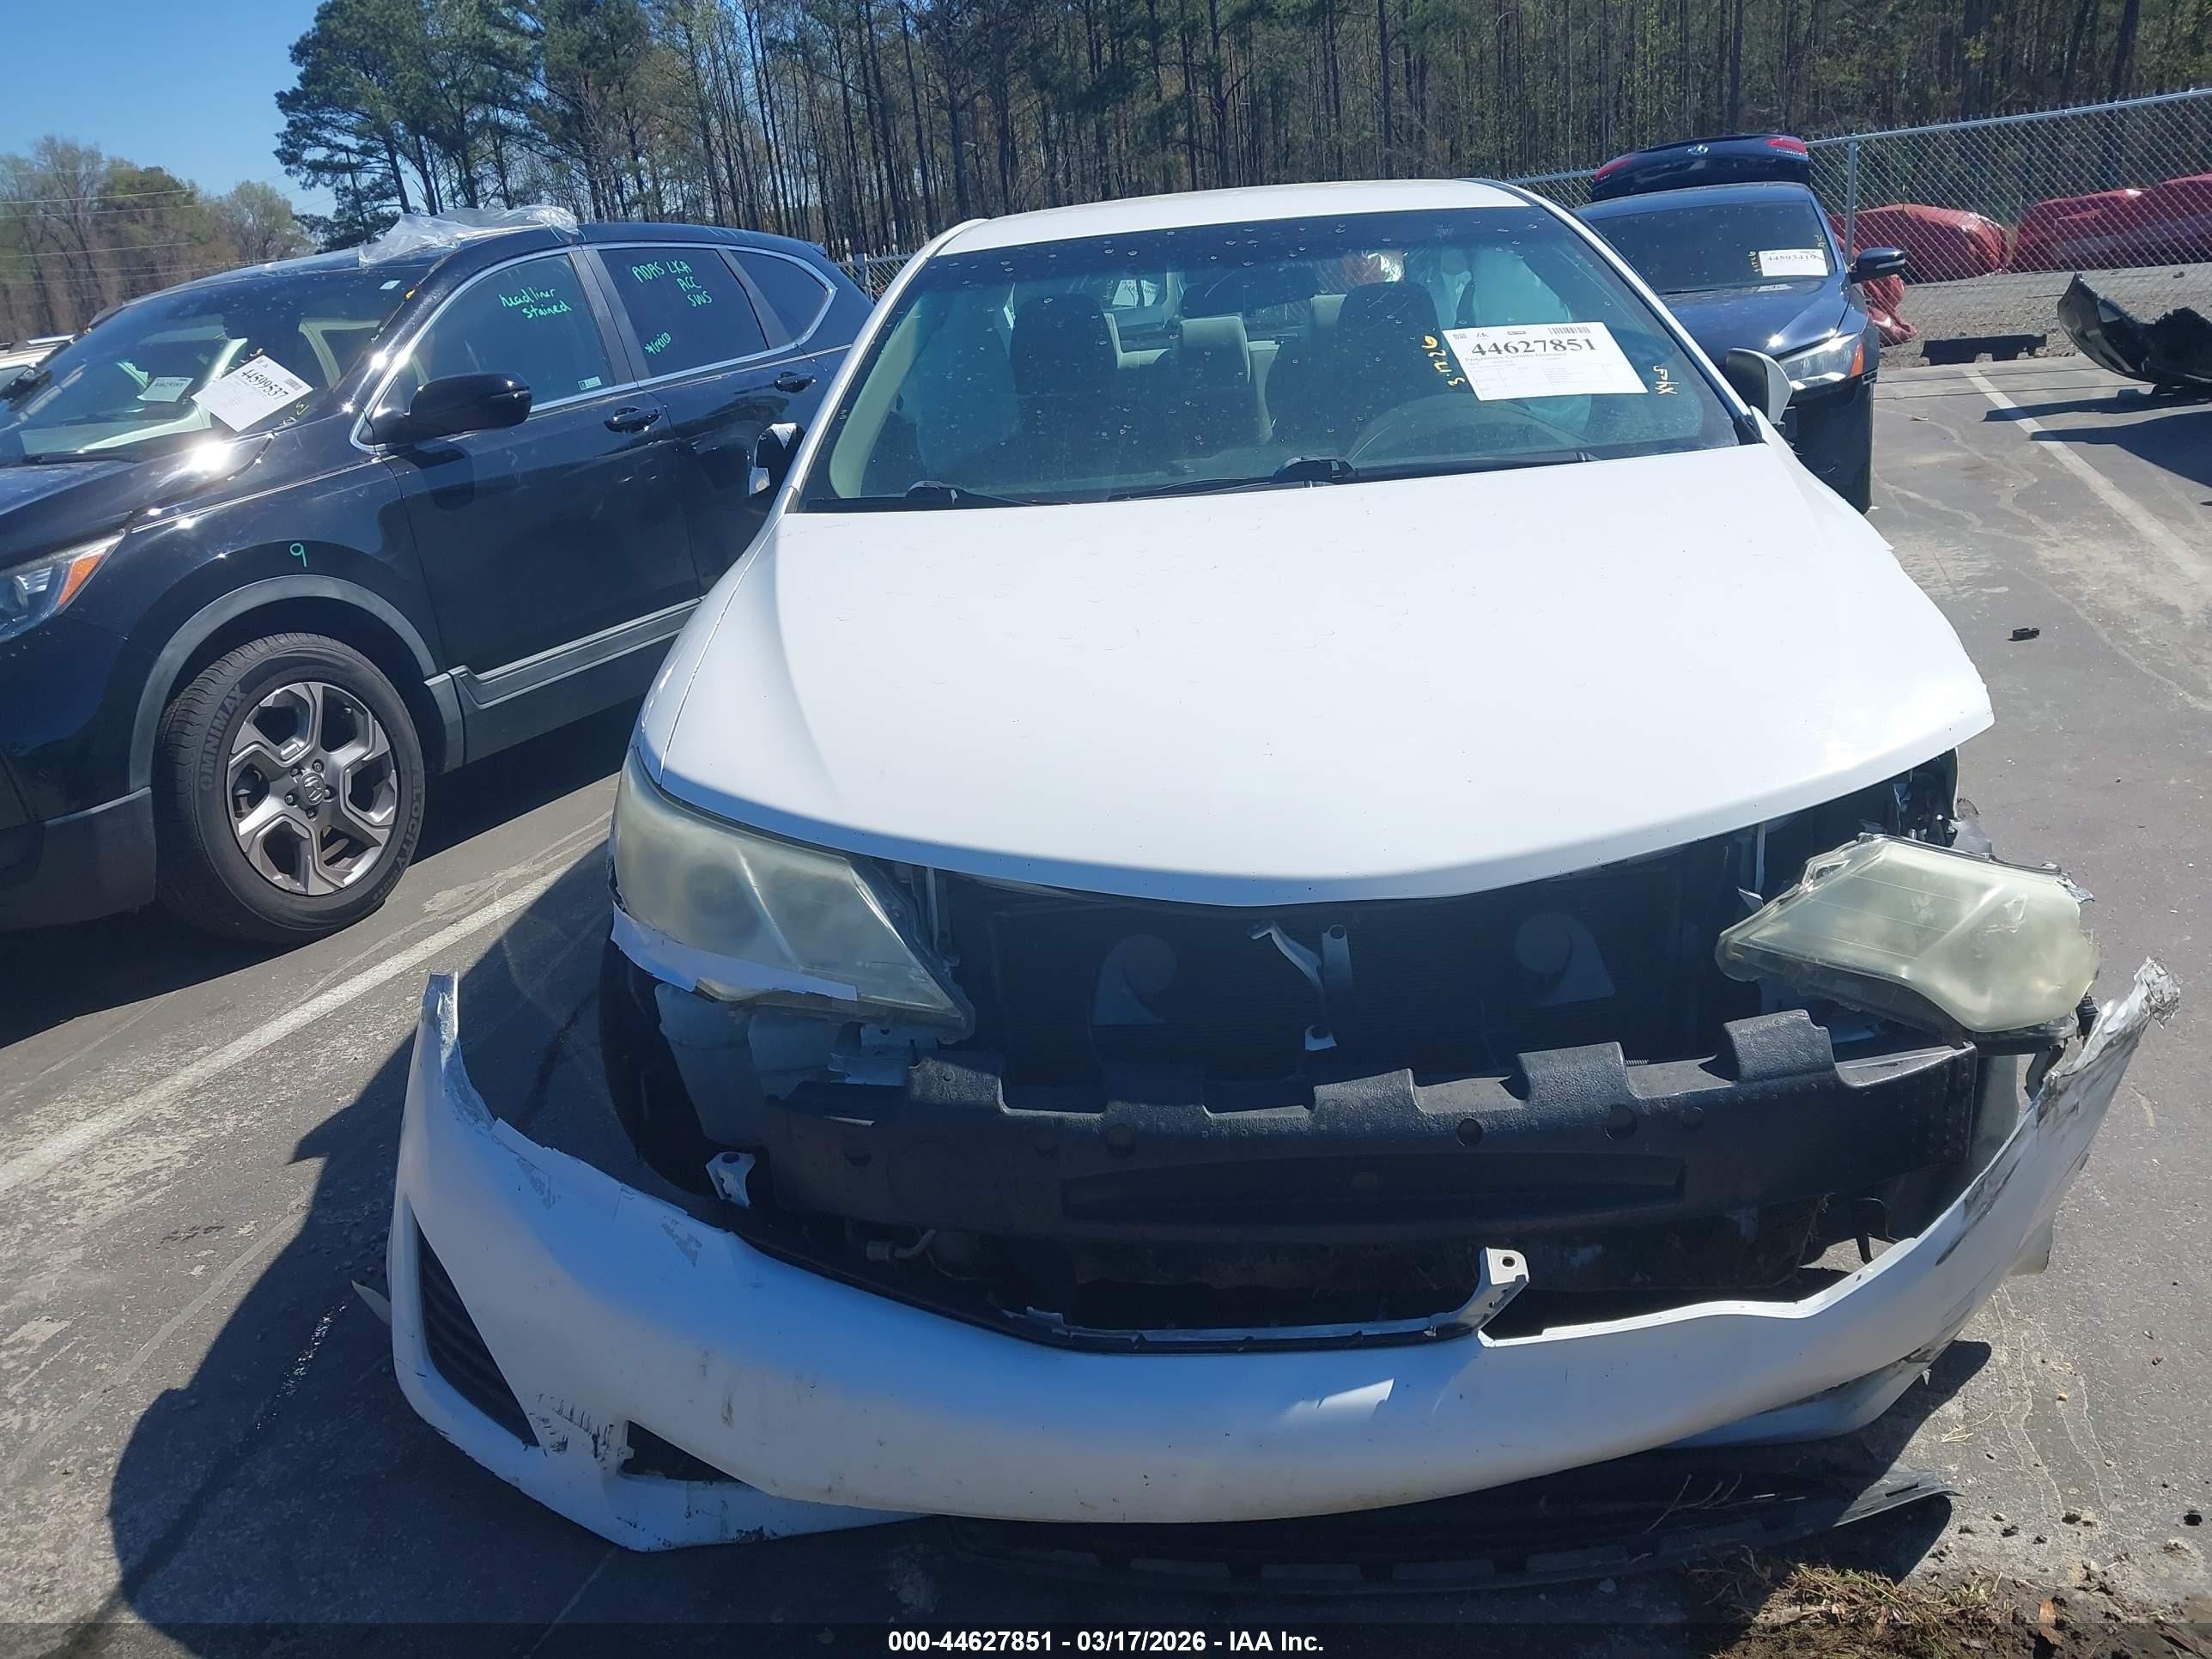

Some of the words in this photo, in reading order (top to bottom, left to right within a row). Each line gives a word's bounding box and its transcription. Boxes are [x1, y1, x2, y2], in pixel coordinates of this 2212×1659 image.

[632, 261, 665, 283] ADAS
[666, 260, 693, 275] LKA
[677, 276, 702, 292] ACC
[687, 290, 712, 307] SWS
[522, 299, 573, 319] stained
[1472, 337, 1598, 356] 44627851
[240, 368, 289, 399] 44599537
[289, 543, 307, 568] 9
